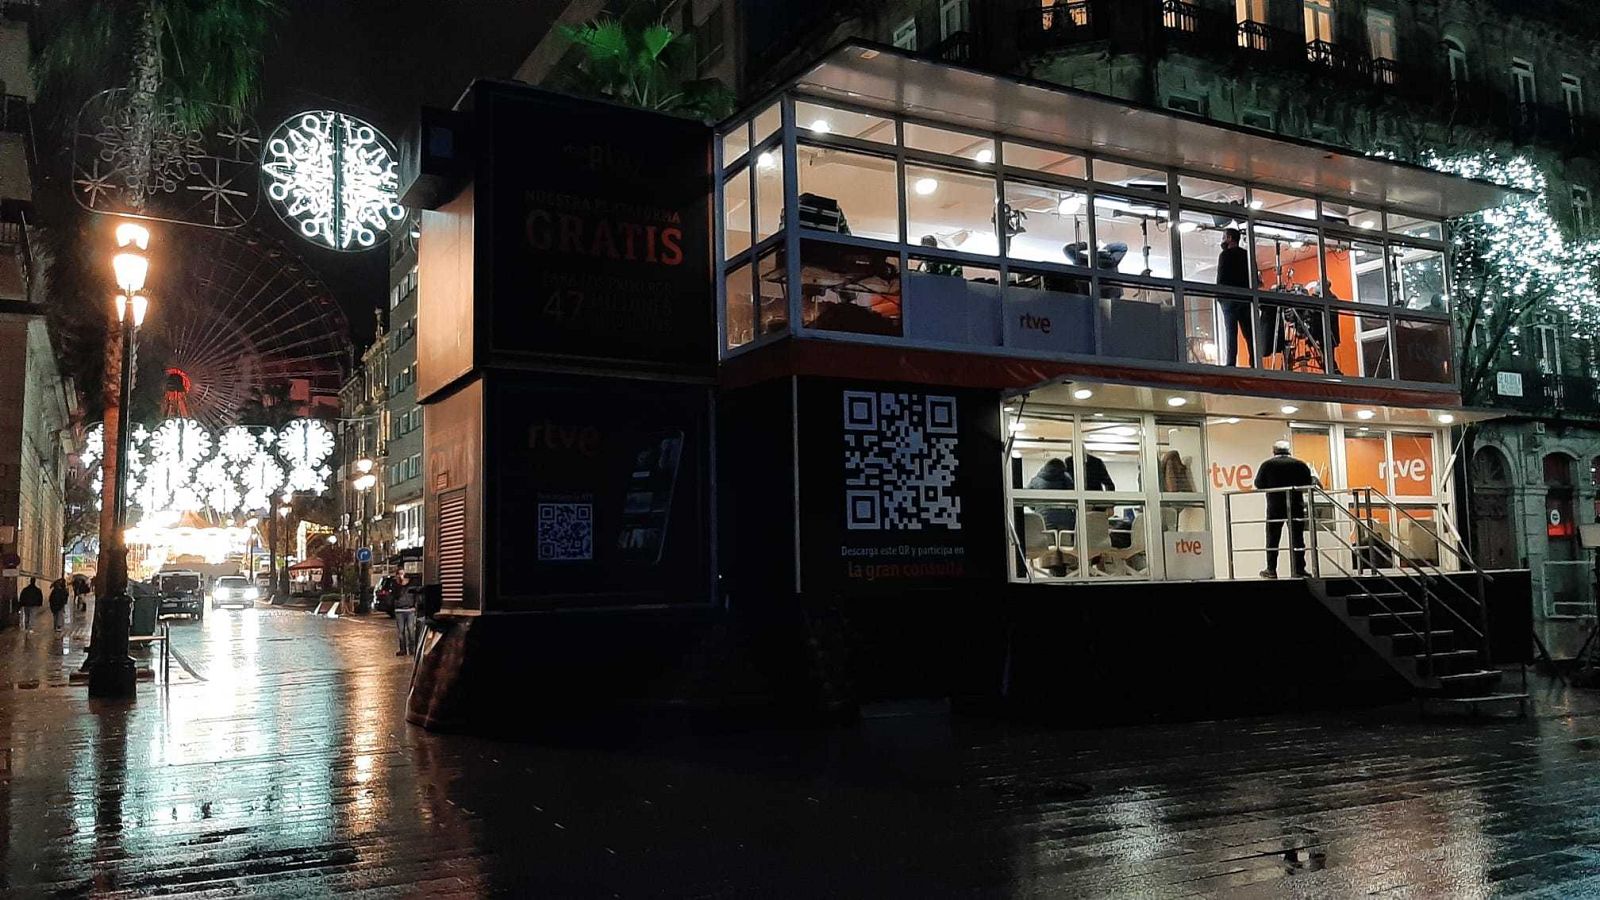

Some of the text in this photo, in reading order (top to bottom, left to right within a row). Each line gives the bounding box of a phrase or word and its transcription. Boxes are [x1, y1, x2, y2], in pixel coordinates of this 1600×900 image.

[524, 208, 684, 267] GRATIS
[542, 287, 585, 321] 47
[1019, 312, 1051, 334] rtve
[527, 418, 602, 458] rtve
[1208, 462, 1253, 492] tve
[1175, 538, 1202, 554] rtve
[865, 563, 901, 581] gran
